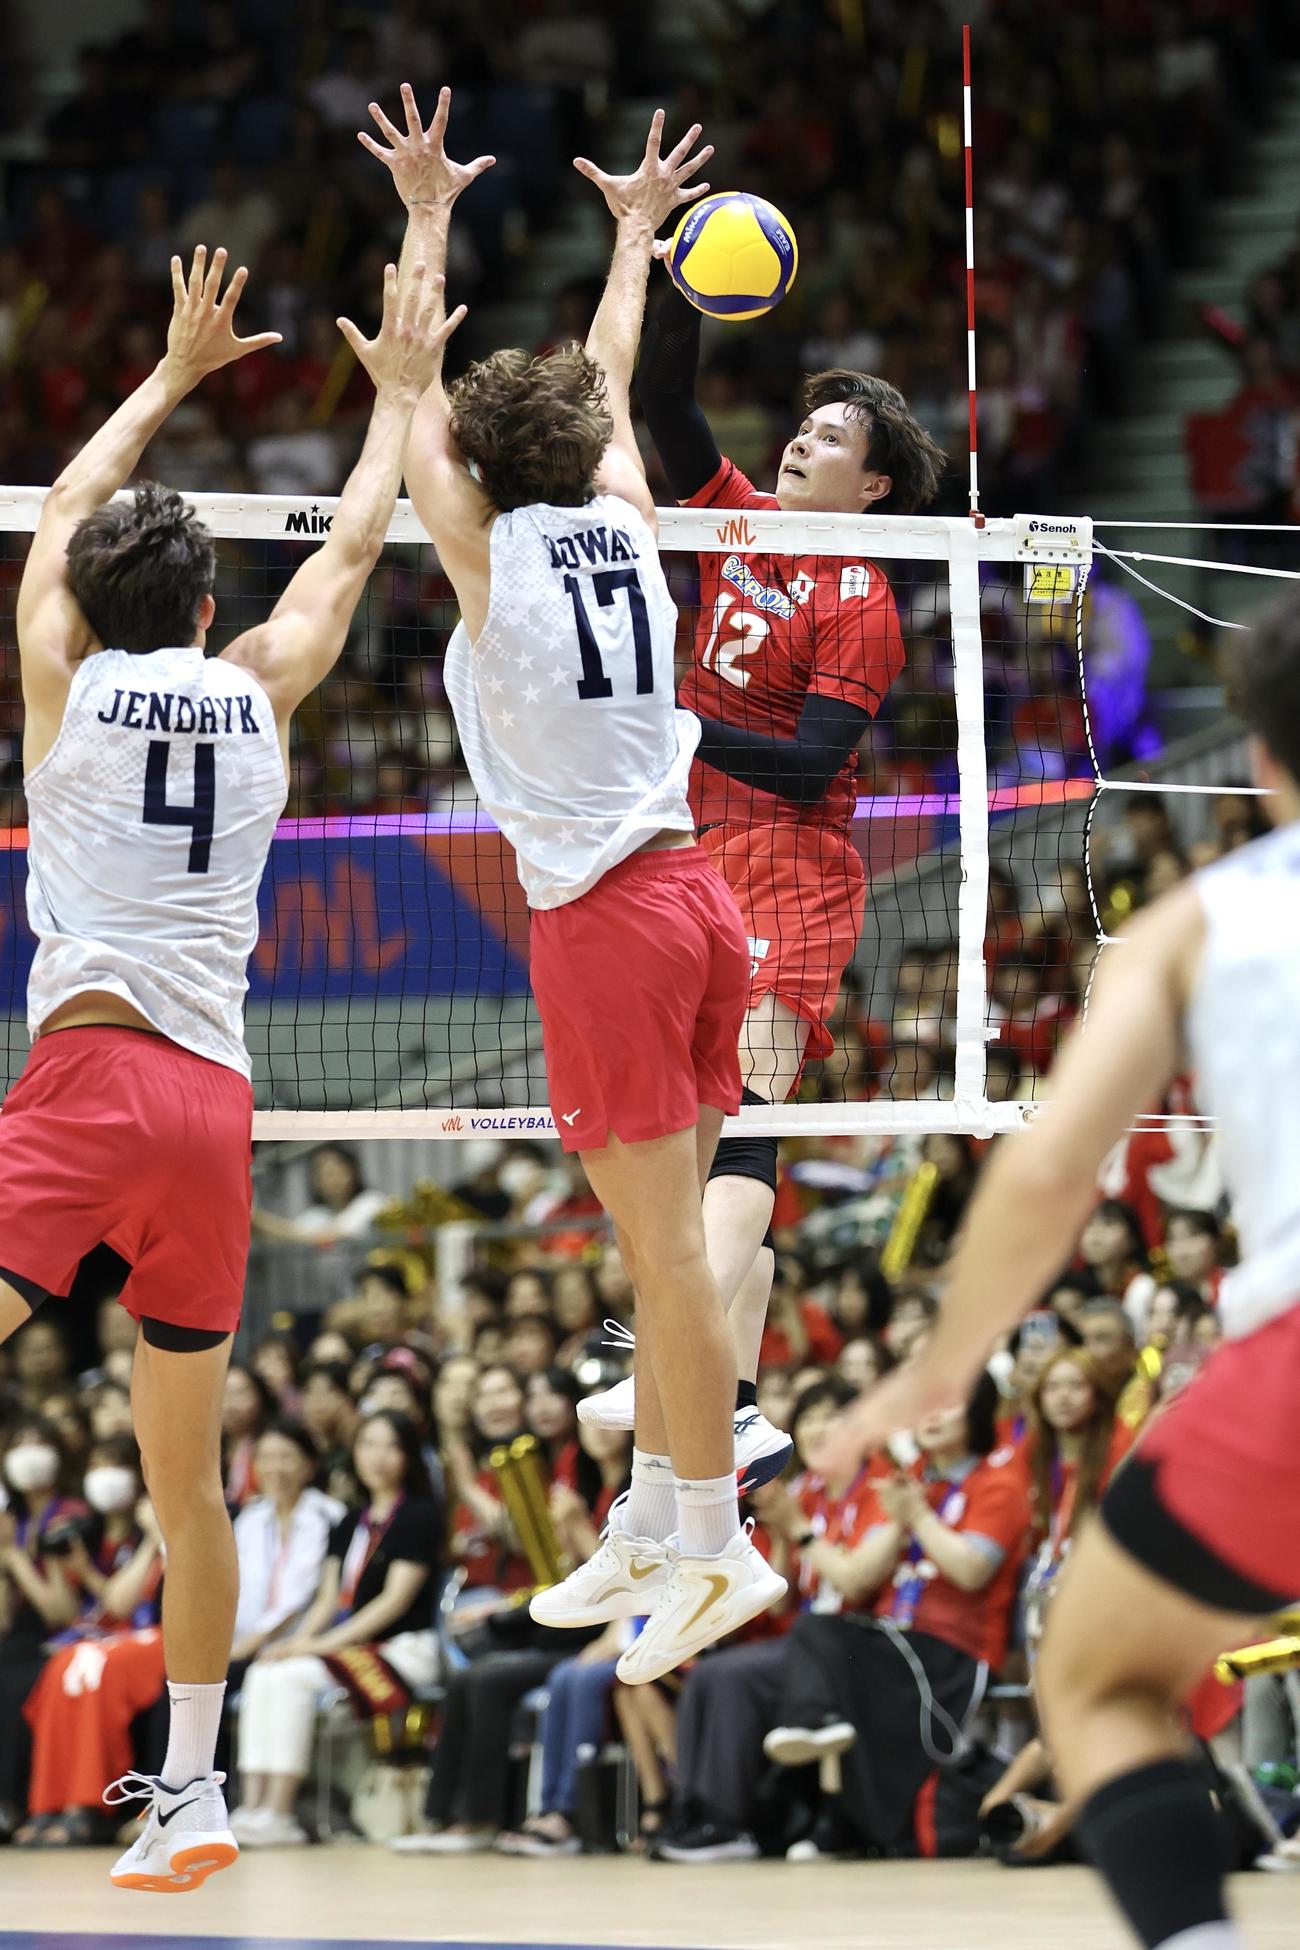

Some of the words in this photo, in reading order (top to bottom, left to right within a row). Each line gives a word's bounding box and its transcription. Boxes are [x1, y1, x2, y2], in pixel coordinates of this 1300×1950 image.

[716, 515, 756, 546] VNL
[1040, 523, 1077, 534] Senoh
[563, 568, 654, 700] 17
[702, 592, 770, 690] 12
[143, 740, 215, 873] 4
[441, 1116, 464, 1132] VNL
[471, 1117, 557, 1129] VOLLEYBAL
